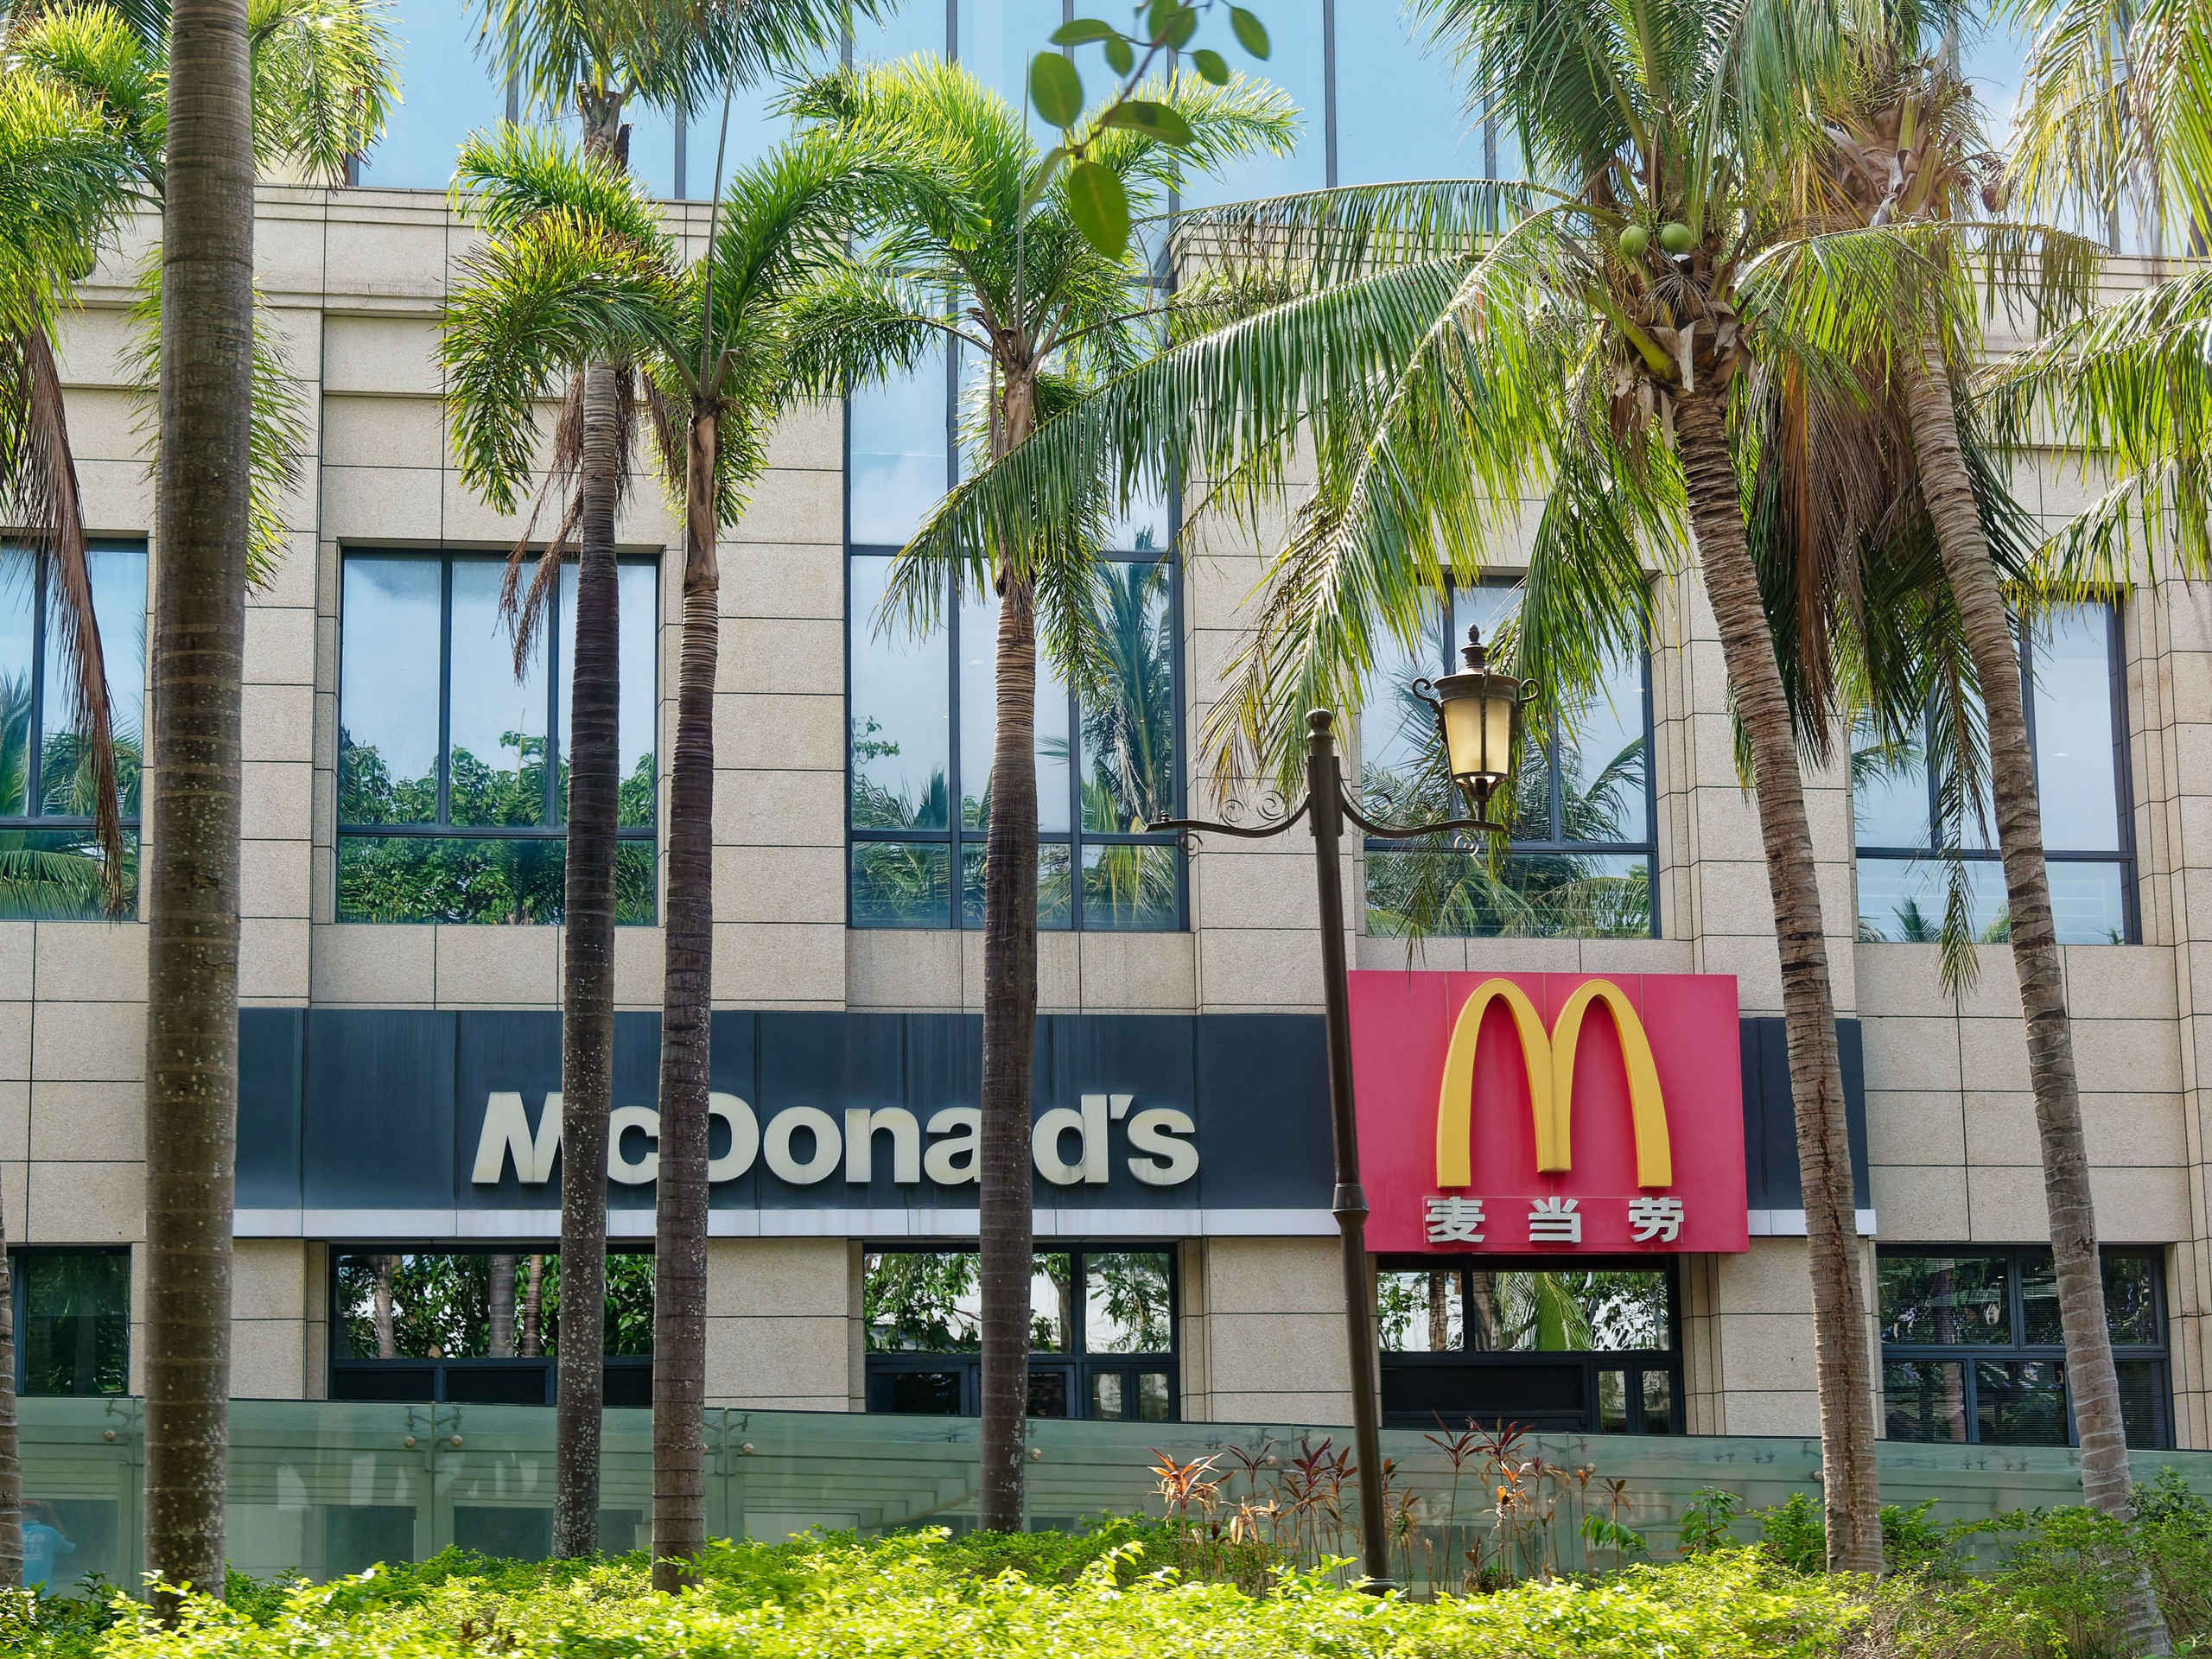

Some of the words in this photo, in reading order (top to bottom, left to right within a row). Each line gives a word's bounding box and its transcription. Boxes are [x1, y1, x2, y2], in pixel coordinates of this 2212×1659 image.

[471, 1091, 1199, 1185] McDonad's
[1426, 1196, 1684, 1243] 麦当劳
